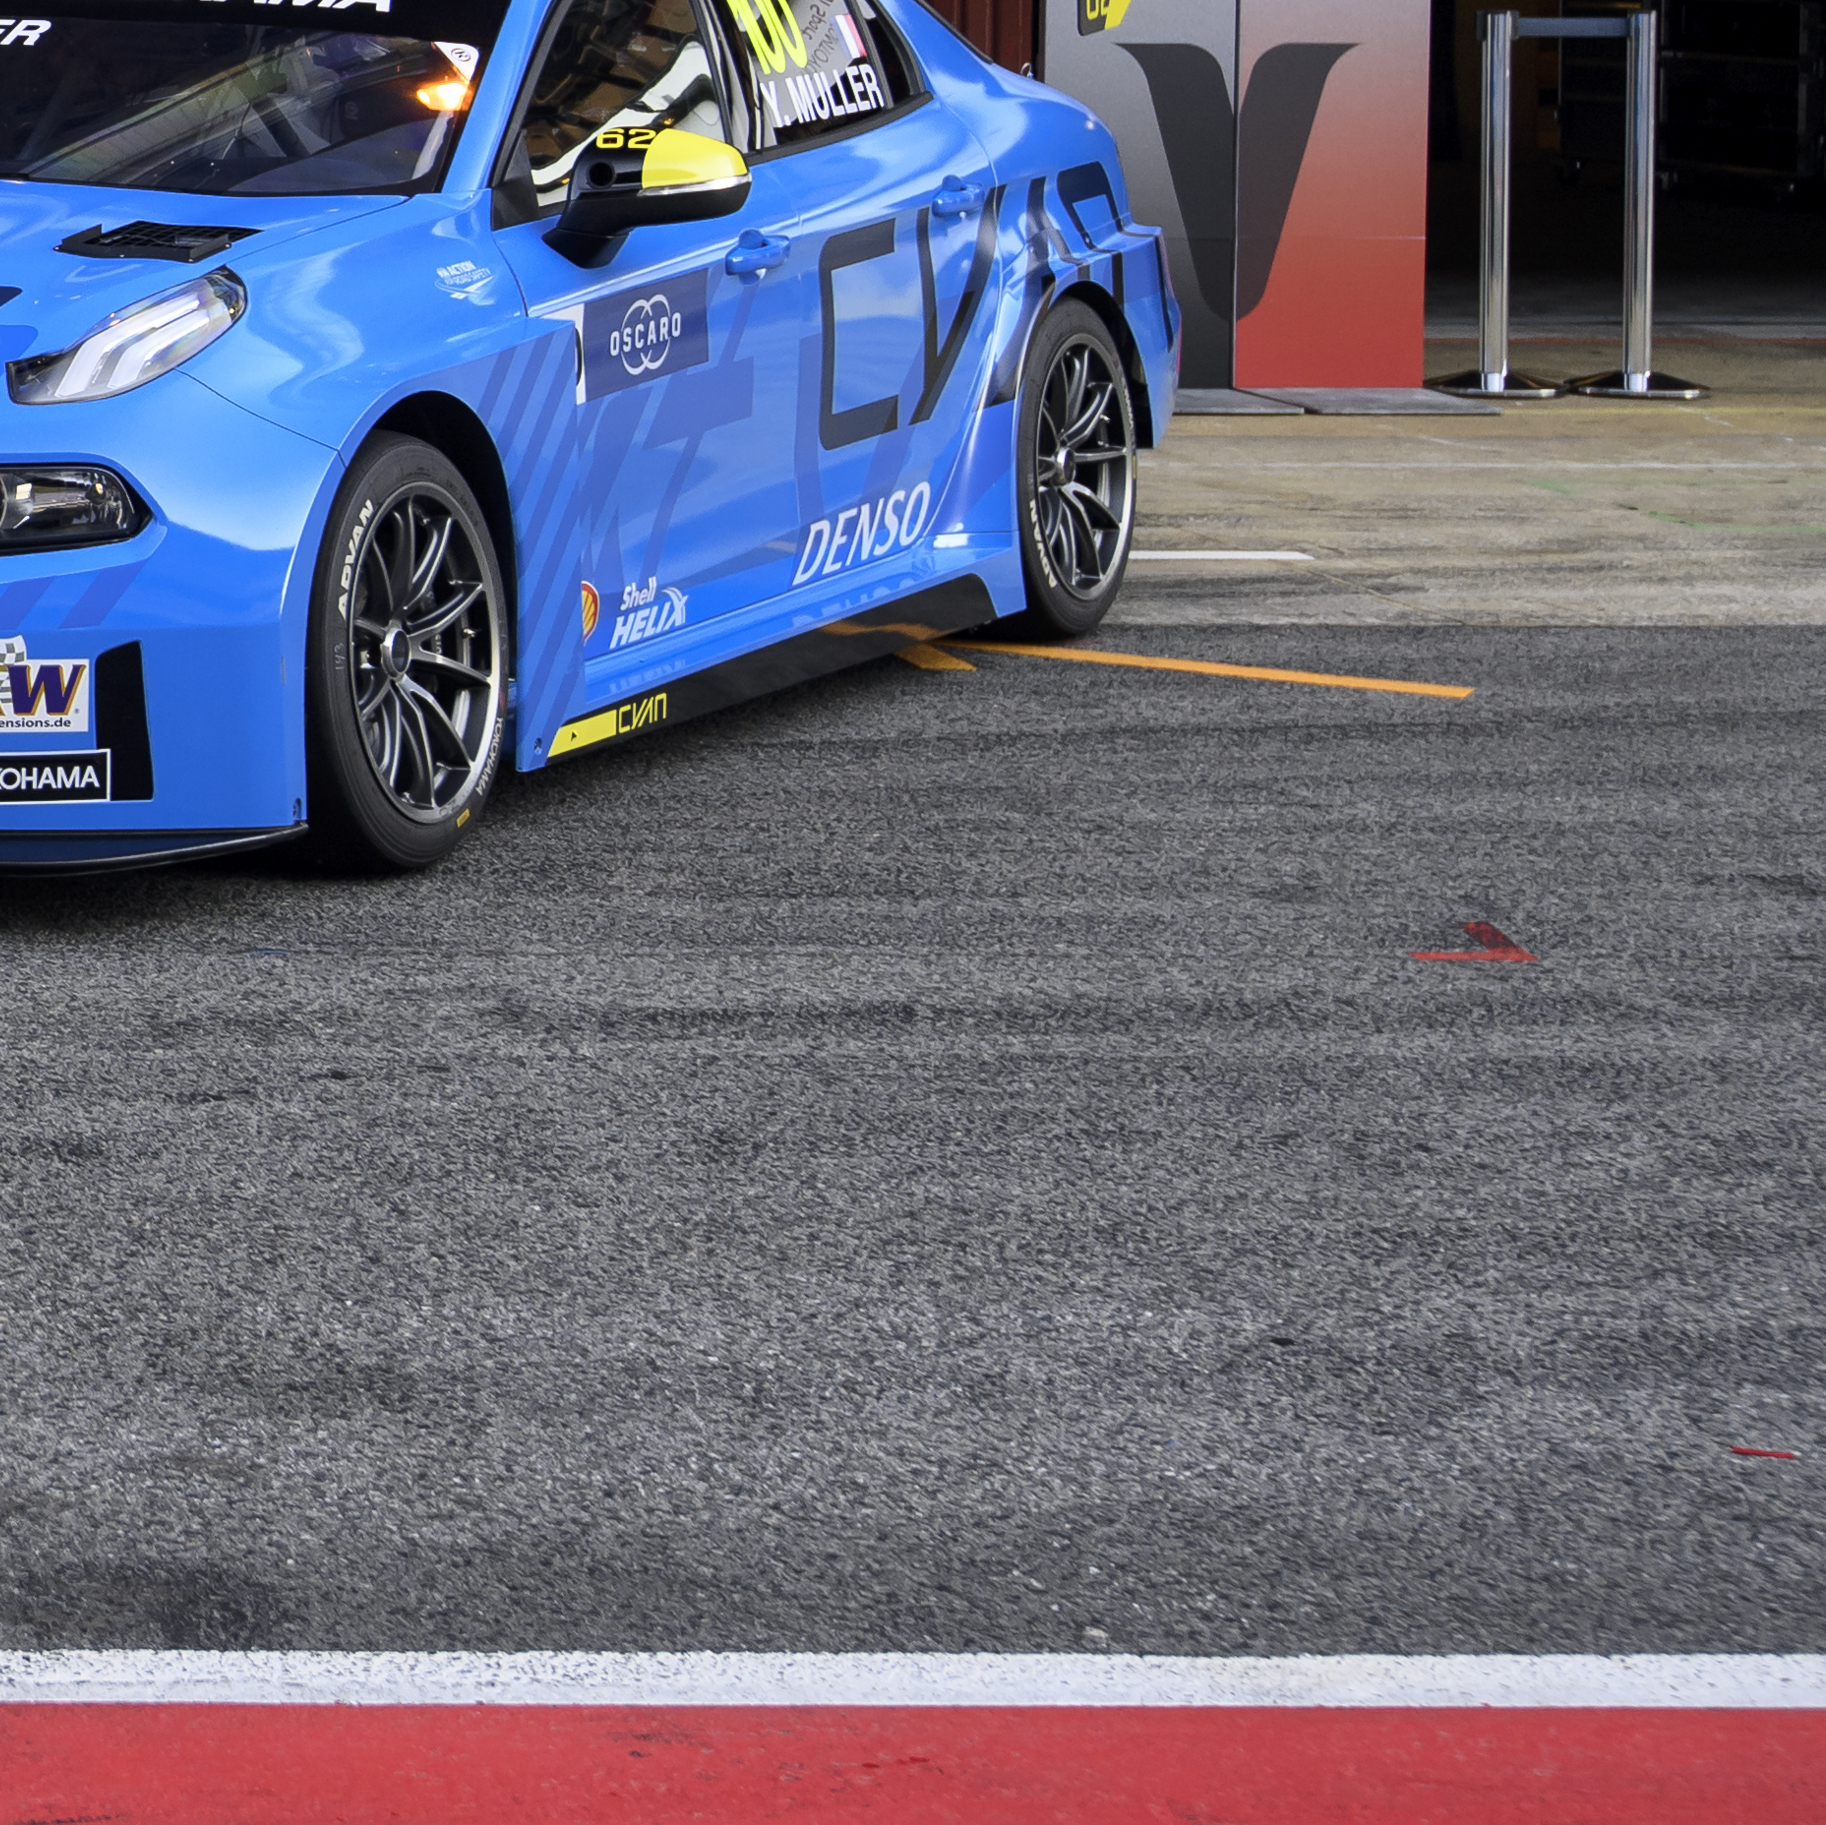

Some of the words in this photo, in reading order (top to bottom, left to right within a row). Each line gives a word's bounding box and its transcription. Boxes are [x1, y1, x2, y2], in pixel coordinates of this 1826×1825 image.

[761, 81, 790, 128] Y.
[786, 64, 884, 125] MULLER
[596, 128, 652, 149] 62
[609, 312, 681, 356] OSCARO
[338, 499, 373, 620] ADVAN
[791, 481, 931, 587] DENSO
[1029, 499, 1058, 588] ADVAN
[610, 586, 689, 649] HELIX
[621, 577, 657, 609] Shell
[619, 694, 667, 734] CYAN
[476, 716, 504, 797] YOKOHAMA
